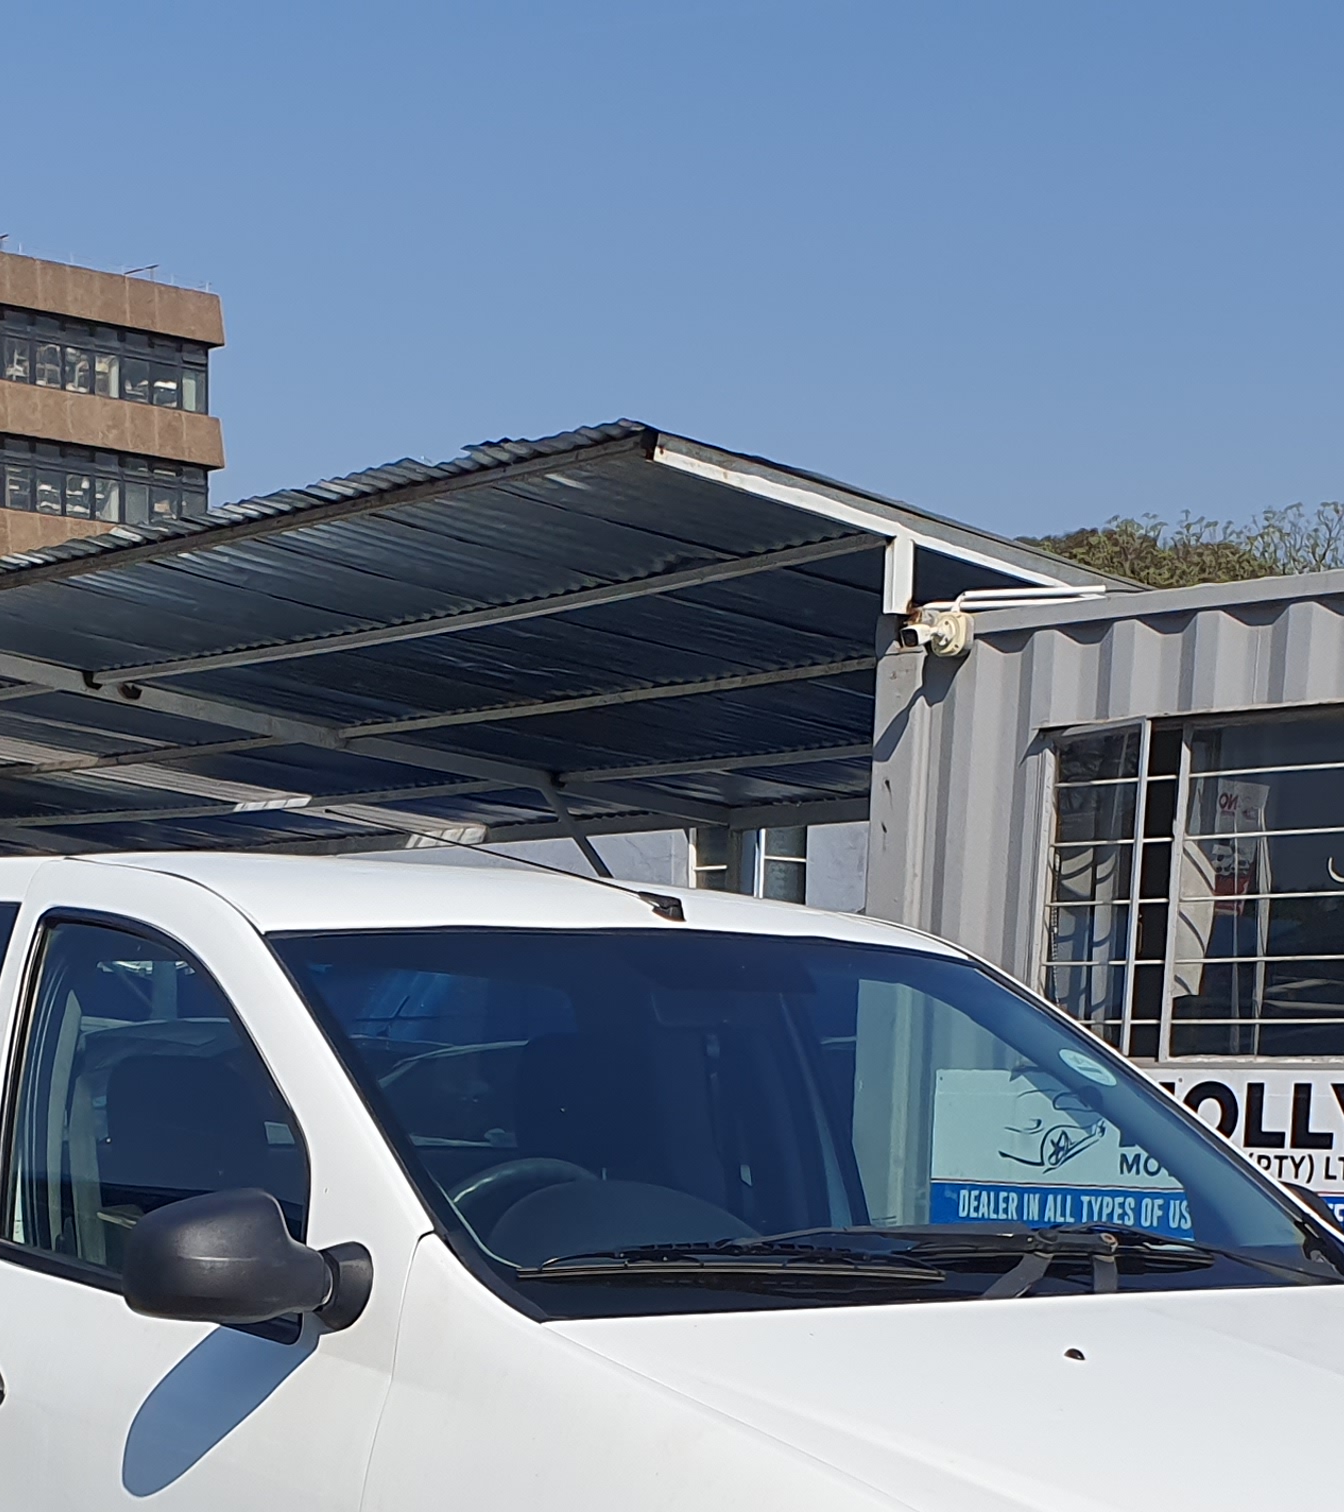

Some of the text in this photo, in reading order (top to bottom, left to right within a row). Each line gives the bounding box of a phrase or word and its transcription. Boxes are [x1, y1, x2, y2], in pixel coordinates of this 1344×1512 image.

[958, 1189, 1018, 1221] DEALER
[1023, 1191, 1040, 1221] IN
[1044, 1193, 1075, 1223] ALL
[1080, 1195, 1135, 1228] TYPES
[1140, 1197, 1164, 1228] OF
